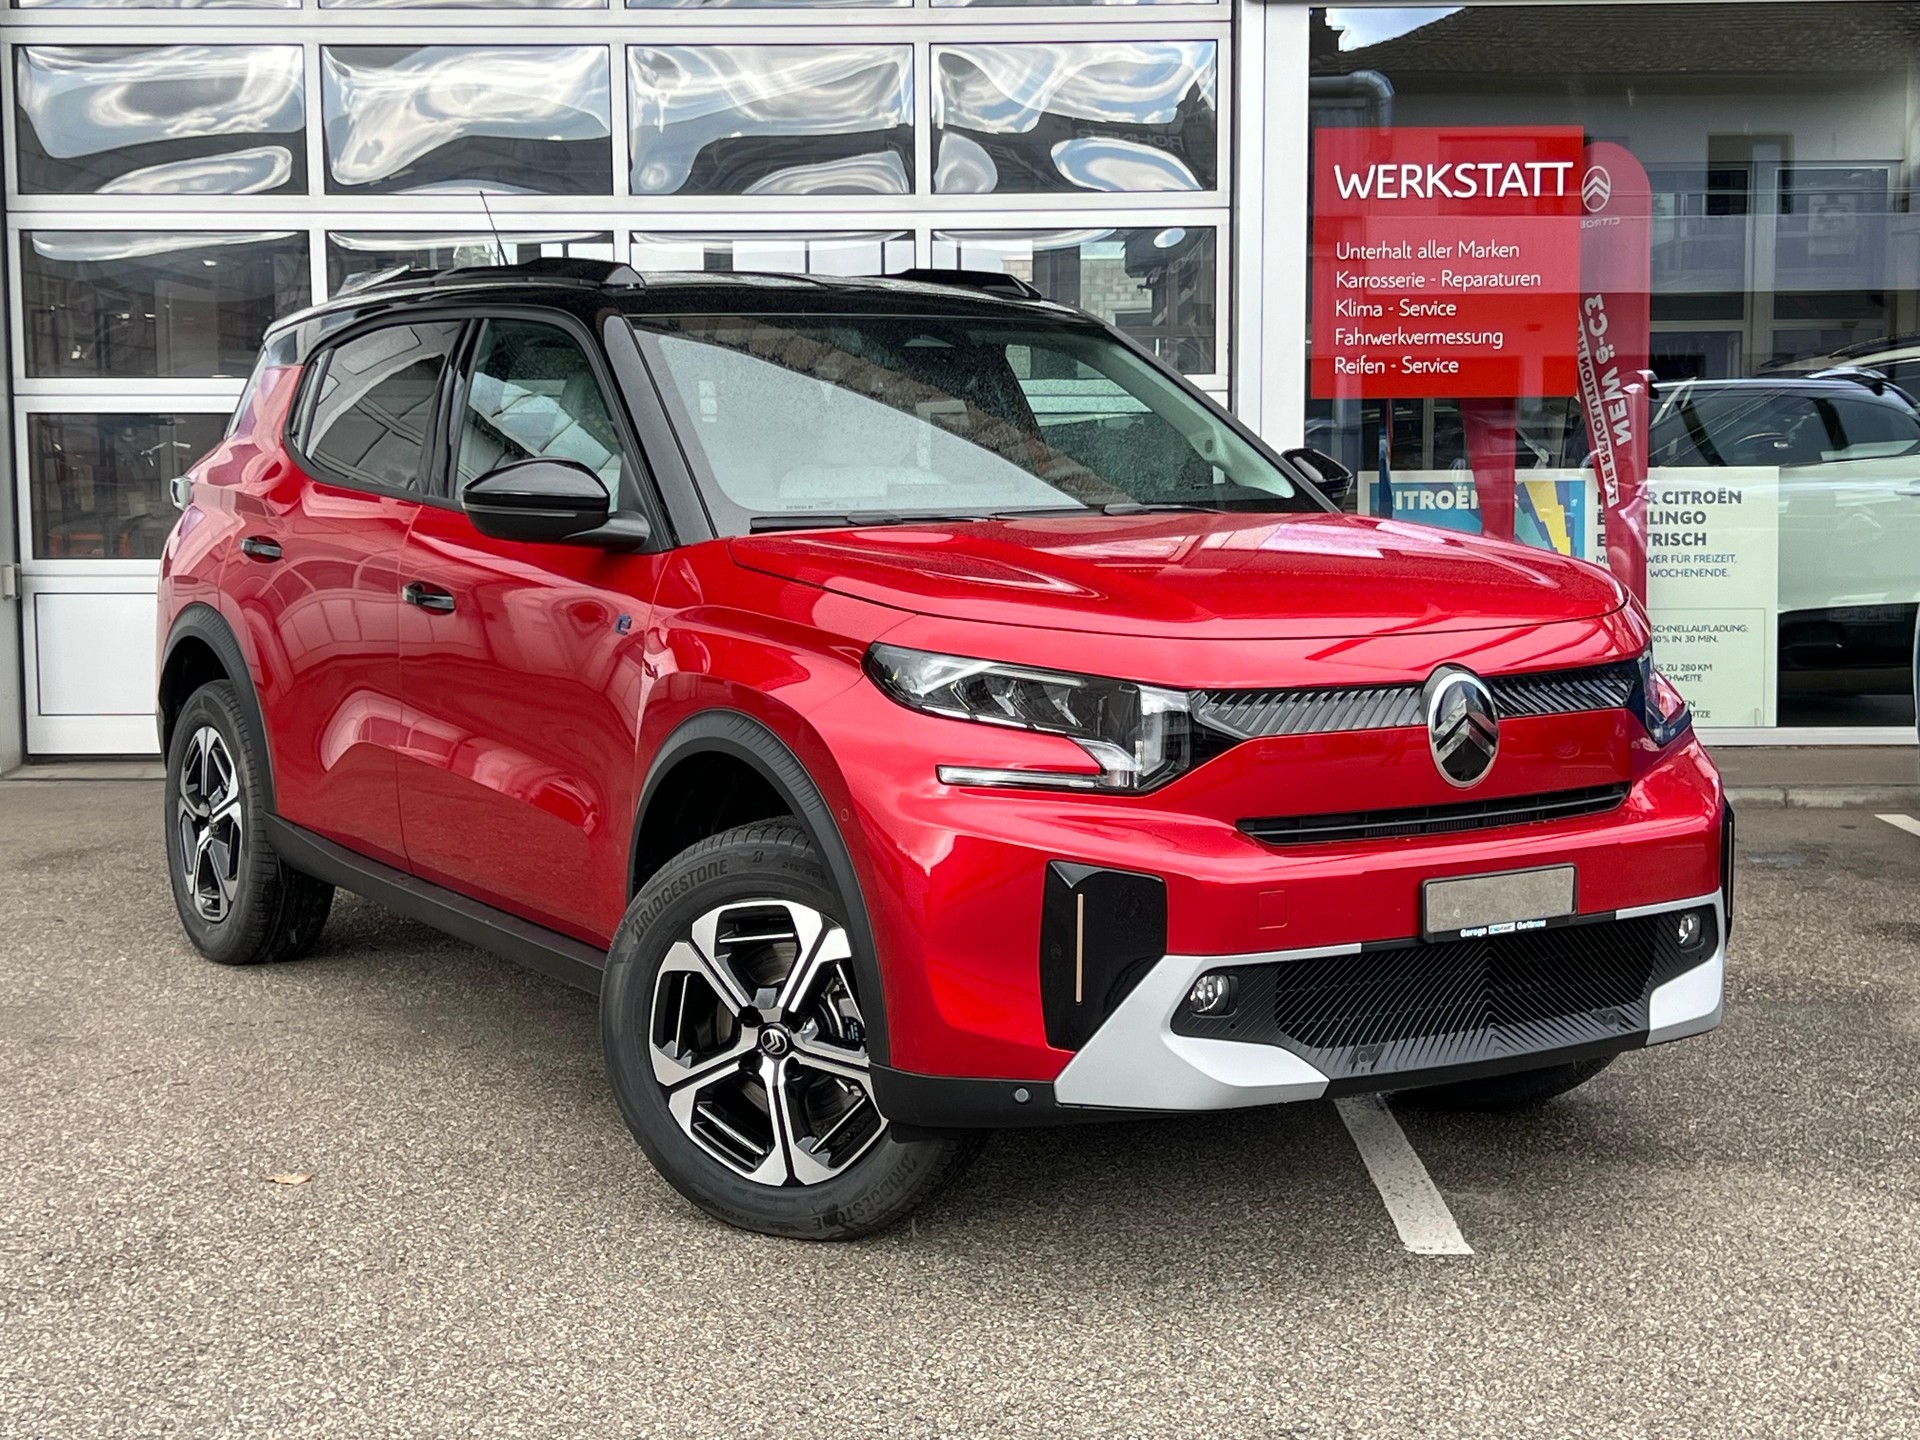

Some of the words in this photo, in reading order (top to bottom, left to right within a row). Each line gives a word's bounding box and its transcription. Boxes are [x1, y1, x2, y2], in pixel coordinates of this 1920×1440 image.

[1334, 161, 1574, 199] WERKSTATT
[1336, 240, 1412, 260] Unterhalt
[1417, 239, 1453, 259] aller
[1458, 239, 1520, 259] Marken
[1336, 271, 1425, 289] Karrosserie
[1441, 269, 1541, 292] Reparaturen
[1335, 298, 1383, 317] Klima
[1399, 298, 1457, 317] Service
[1335, 326, 1504, 350] Fahrwerkvermessung
[1334, 355, 1386, 374] Reifen
[1401, 355, 1459, 374] Service
[1662, 487, 1742, 505] CITROËN
[1671, 553, 1691, 563] FÜR
[1694, 554, 1738, 565] FREIZEIT,
[1649, 568, 1730, 578] WOCHENENDE.
[630, 858, 729, 944] BRIDGESTONE
